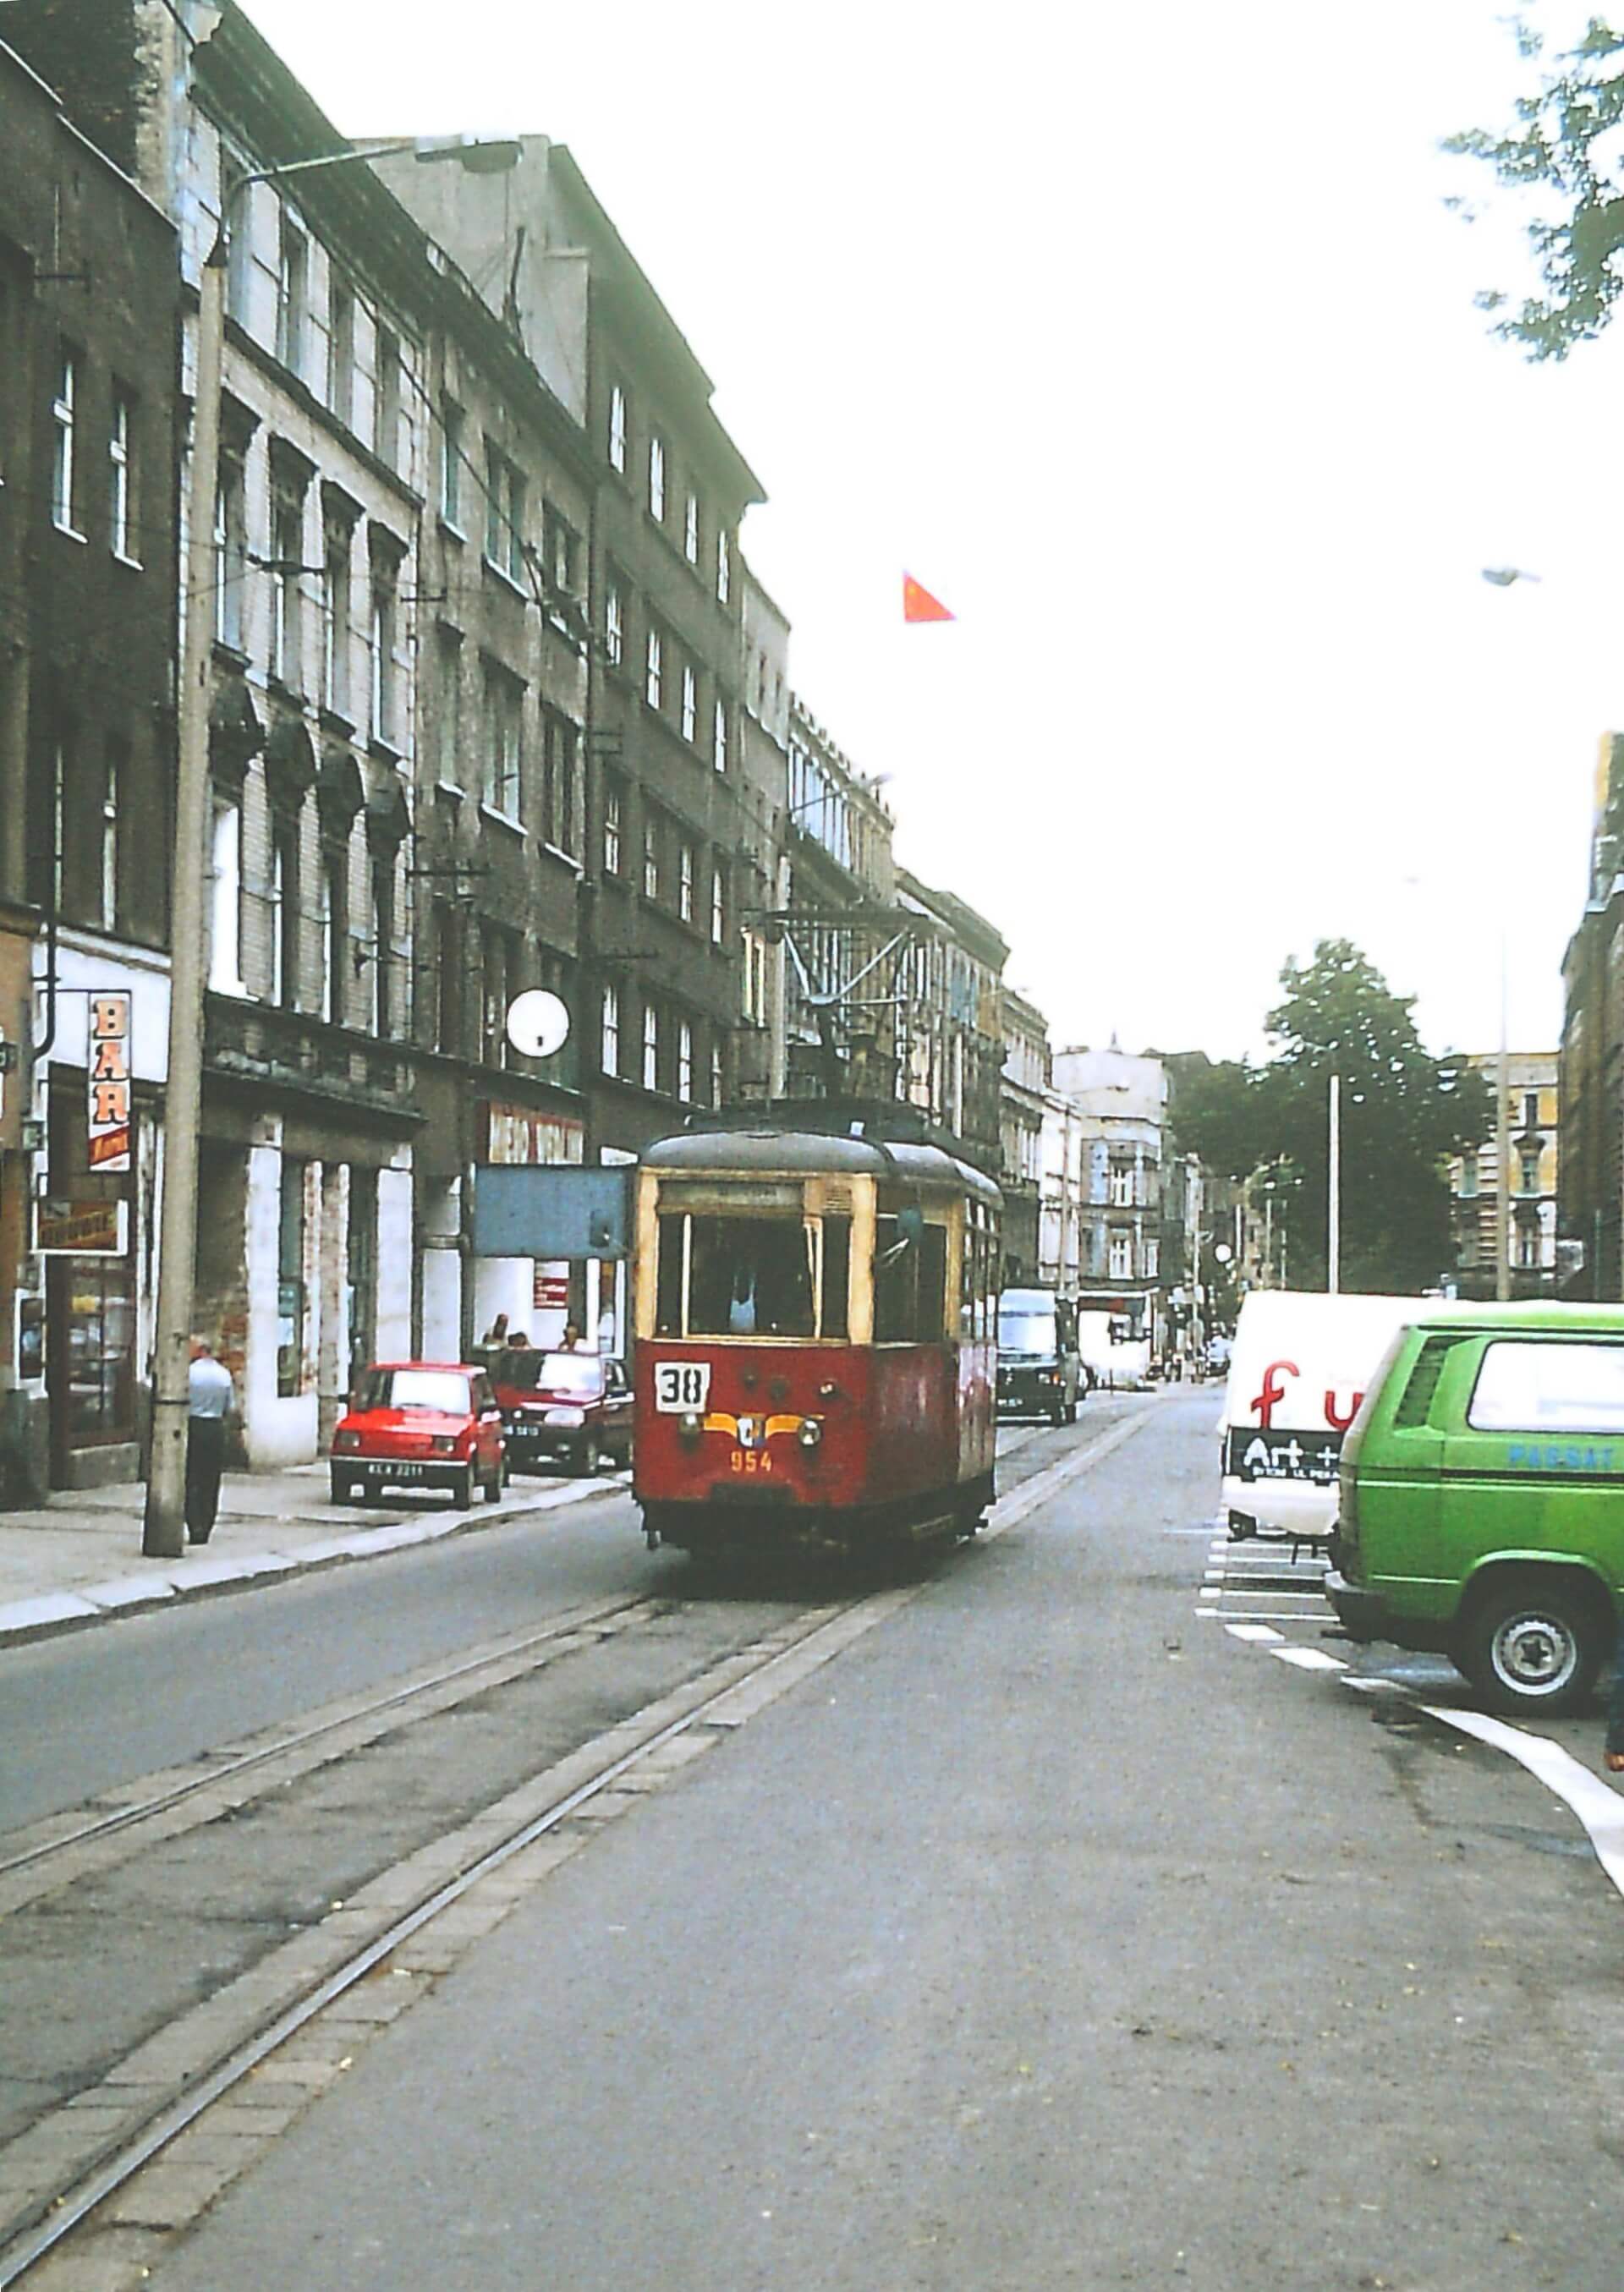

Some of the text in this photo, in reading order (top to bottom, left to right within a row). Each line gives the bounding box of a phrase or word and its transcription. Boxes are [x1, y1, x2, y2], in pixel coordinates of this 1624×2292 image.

[92, 1000, 129, 1124] BAR
[661, 1368, 702, 1404] 38
[730, 1450, 772, 1472] 954
[1243, 1437, 1304, 1468] Art
